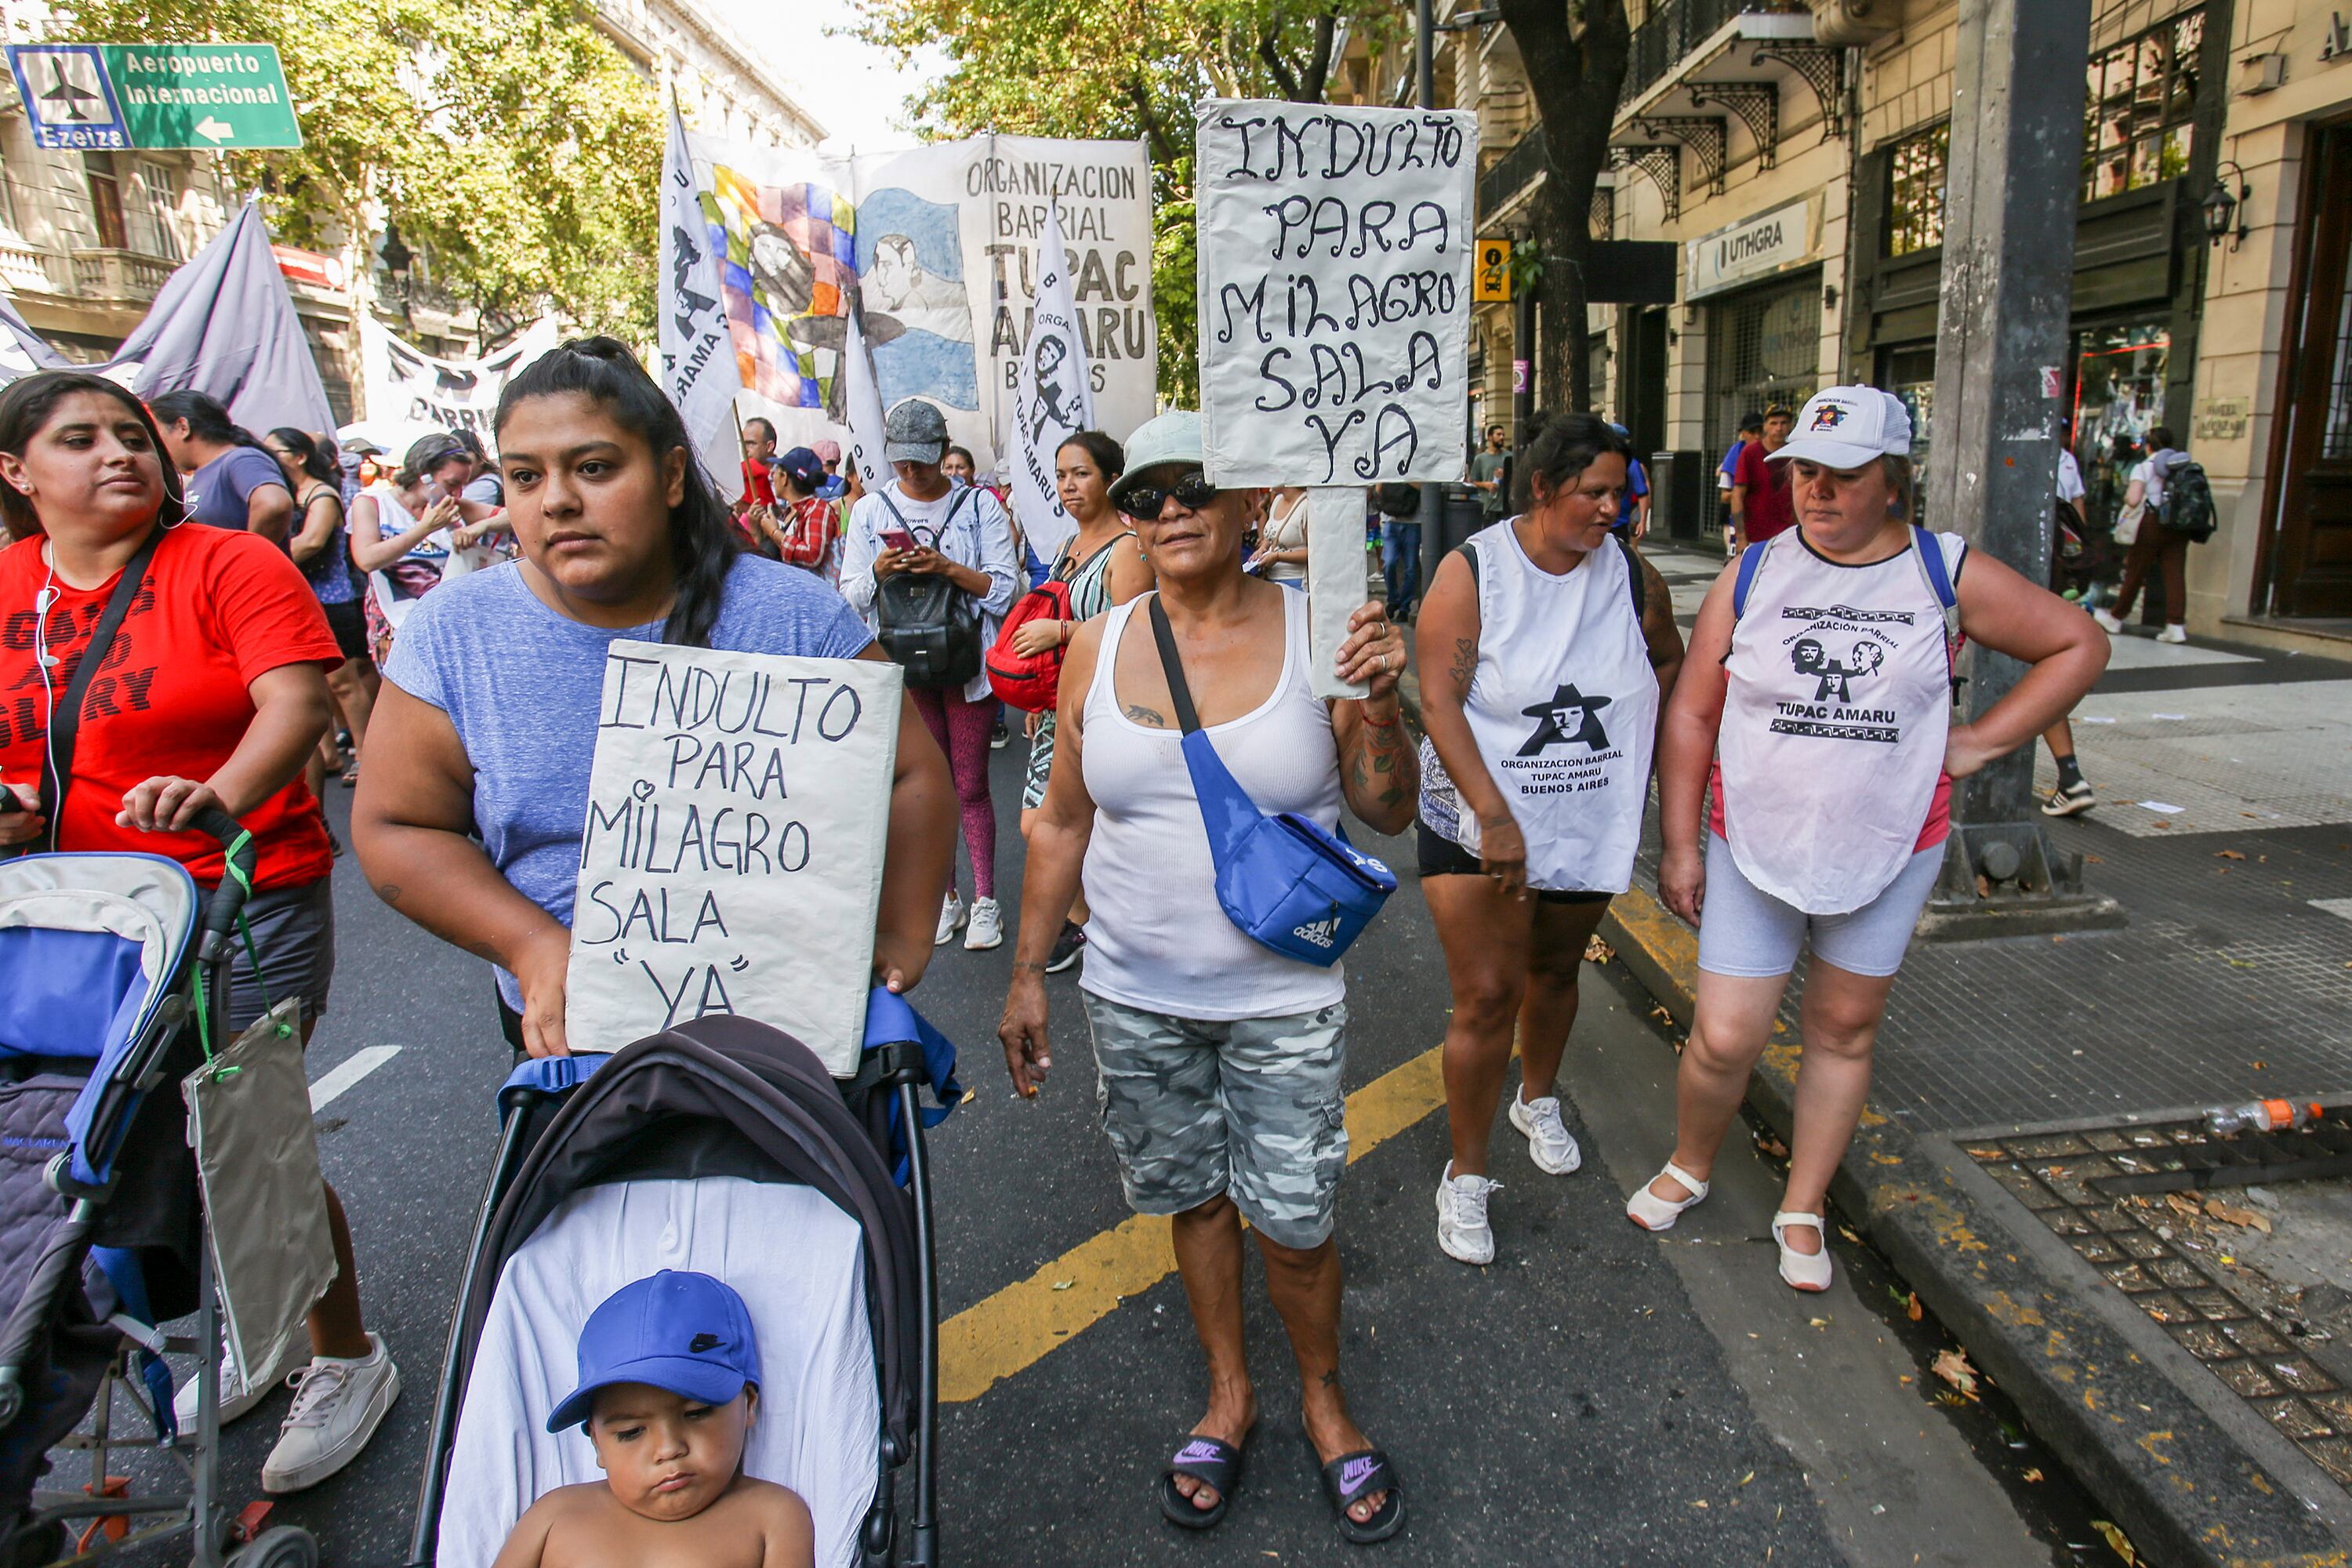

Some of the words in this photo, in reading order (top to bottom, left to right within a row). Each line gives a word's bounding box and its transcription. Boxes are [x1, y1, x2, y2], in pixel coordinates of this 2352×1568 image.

[126, 52, 260, 78] Aeropuerto
[125, 83, 278, 105] Internacional
[40, 126, 123, 148] Ezeiza
[1221, 114, 1463, 181] INDULTO
[966, 157, 1135, 200] ORGANIZACION
[996, 201, 1115, 241] BARRIAL
[1262, 194, 1448, 260] PARA
[1730, 220, 1783, 263] UTHGRA
[1255, 330, 1442, 412] SALA
[1305, 403, 1418, 483] YA
[1024, 444, 1056, 502] AMARU
[600, 654, 862, 744] INDULTO
[1777, 702, 1828, 719] TUPAC
[1833, 708, 1896, 724] AMARU
[663, 733, 788, 800] PARA
[1501, 757, 1583, 769] ORGANIZACION
[1584, 750, 1624, 765] BARRIAL
[1531, 772, 1565, 781] TUPAC
[1568, 767, 1602, 780] AMARU
[1521, 784, 1573, 794] BUENOS
[1577, 777, 1609, 792] AIRES
[581, 880, 729, 944] SALA
[1294, 926, 1333, 948] adidas
[1182, 1441, 1221, 1459] NIKE
[1343, 1455, 1374, 1481] NIKE
